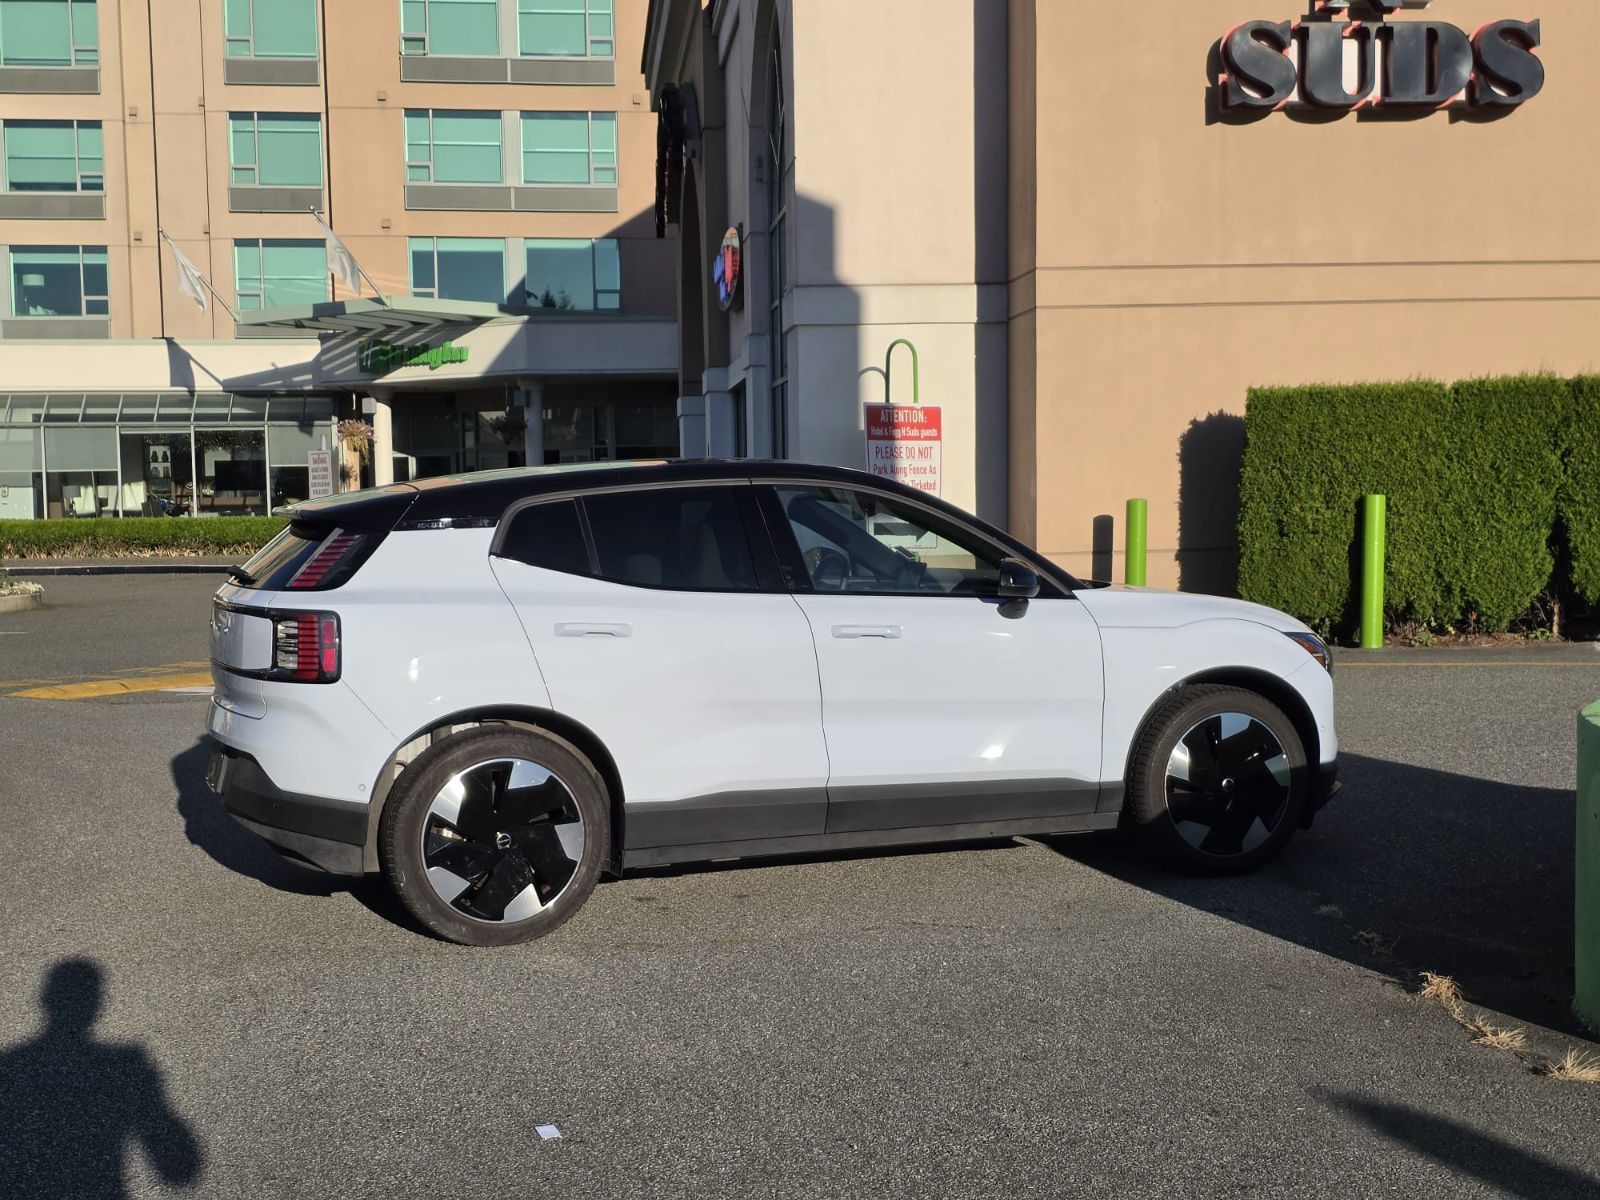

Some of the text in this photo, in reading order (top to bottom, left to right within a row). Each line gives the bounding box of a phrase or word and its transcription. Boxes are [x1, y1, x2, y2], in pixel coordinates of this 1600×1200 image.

[1220, 19, 1545, 110] SUDS
[880, 410, 927, 423] ATTENTION:
[901, 426, 906, 436] N
[906, 426, 920, 437] Suds
[920, 427, 938, 439] guests
[875, 446, 934, 459] PLEASE DO NOT
[873, 464, 937, 478] Park Along Fence As
